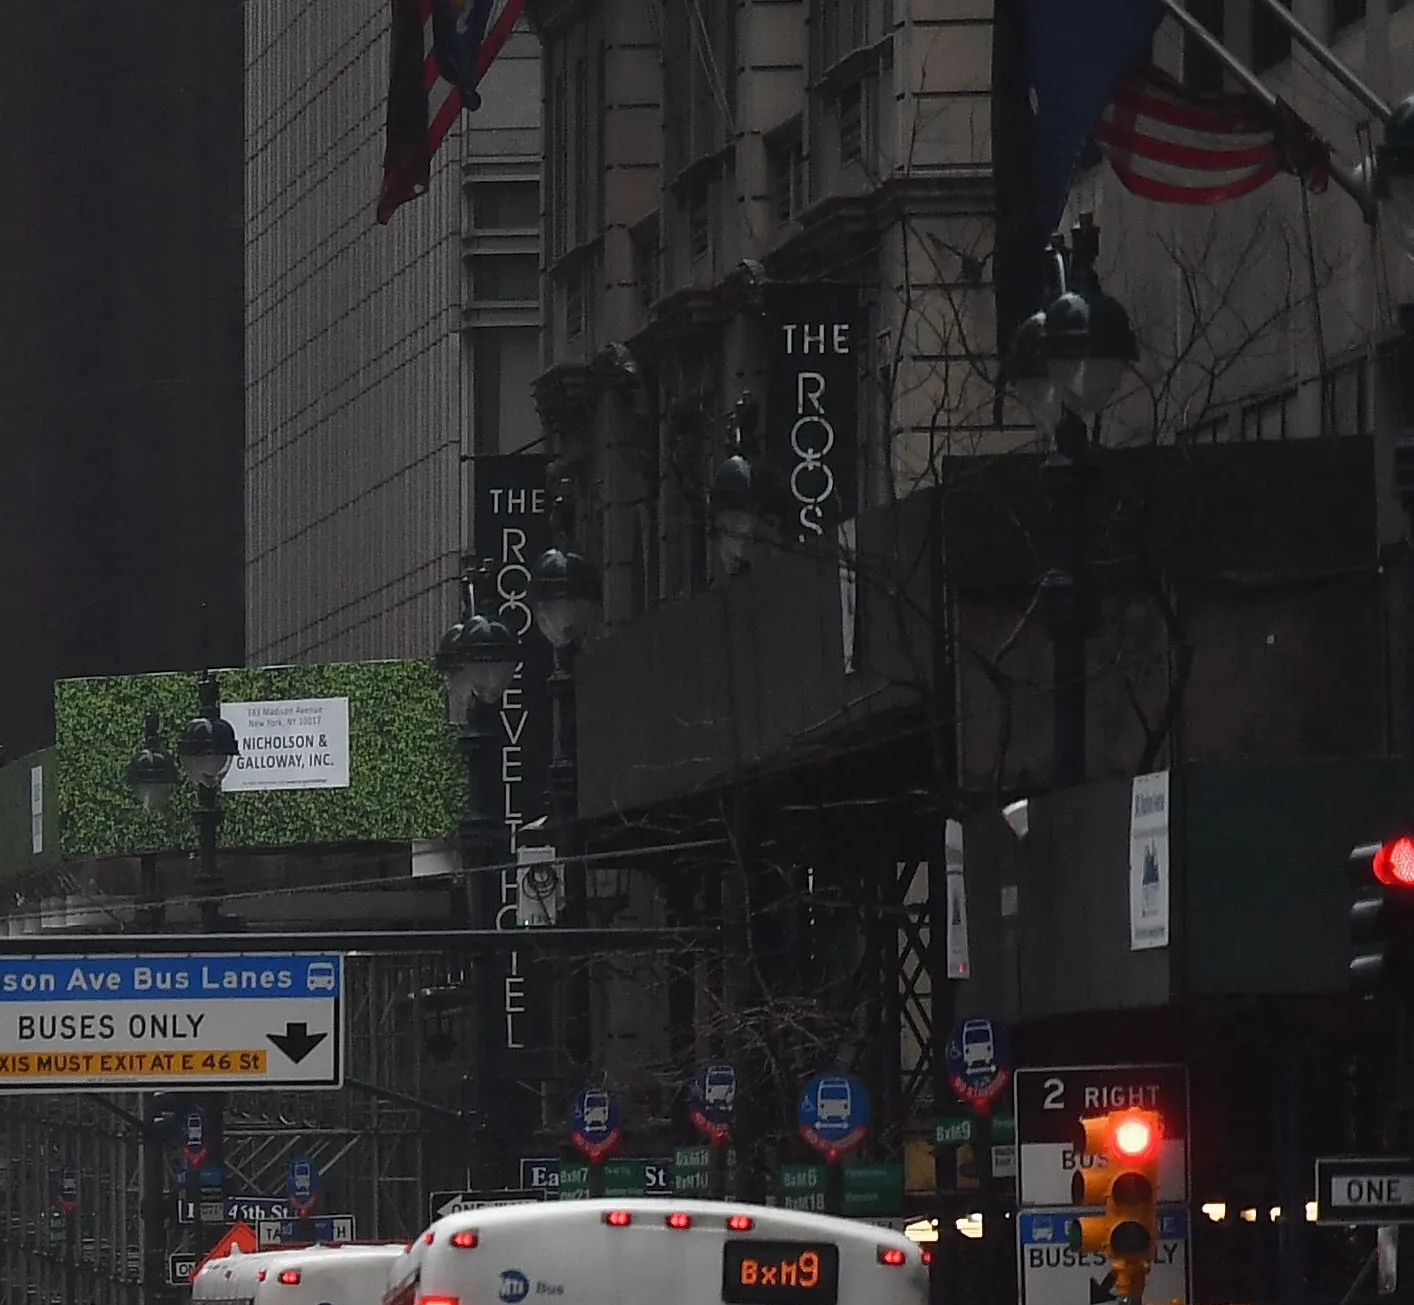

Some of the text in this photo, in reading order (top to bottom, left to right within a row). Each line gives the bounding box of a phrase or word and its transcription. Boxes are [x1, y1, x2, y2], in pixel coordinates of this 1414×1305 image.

[783, 324, 849, 354] THE
[489, 488, 545, 514] THE
[243, 734, 328, 750] NICHOLSON &
[237, 753, 334, 769] GALLOWAY, INC.
[67, 969, 121, 992] Ave
[134, 966, 190, 991] Bus
[202, 966, 292, 990] Lanes
[19, 1014, 205, 1040] BUSES ONLY
[37, 1055, 91, 1072] MUST
[101, 1055, 148, 1072] EXIT
[150, 1055, 173, 1071] AT
[181, 1055, 192, 1070] E
[202, 1054, 232, 1071] 46
[239, 1054, 260, 1070] St
[1043, 1078, 1161, 1110] 2 RIGHT
[645, 1166, 667, 1187] St
[1347, 1180, 1401, 1202] ONE
[271, 1204, 288, 1218] St
[1030, 1243, 1177, 1267] BUSES LY
[739, 1249, 821, 1289] BxM9
[536, 1280, 564, 1296] Bus
